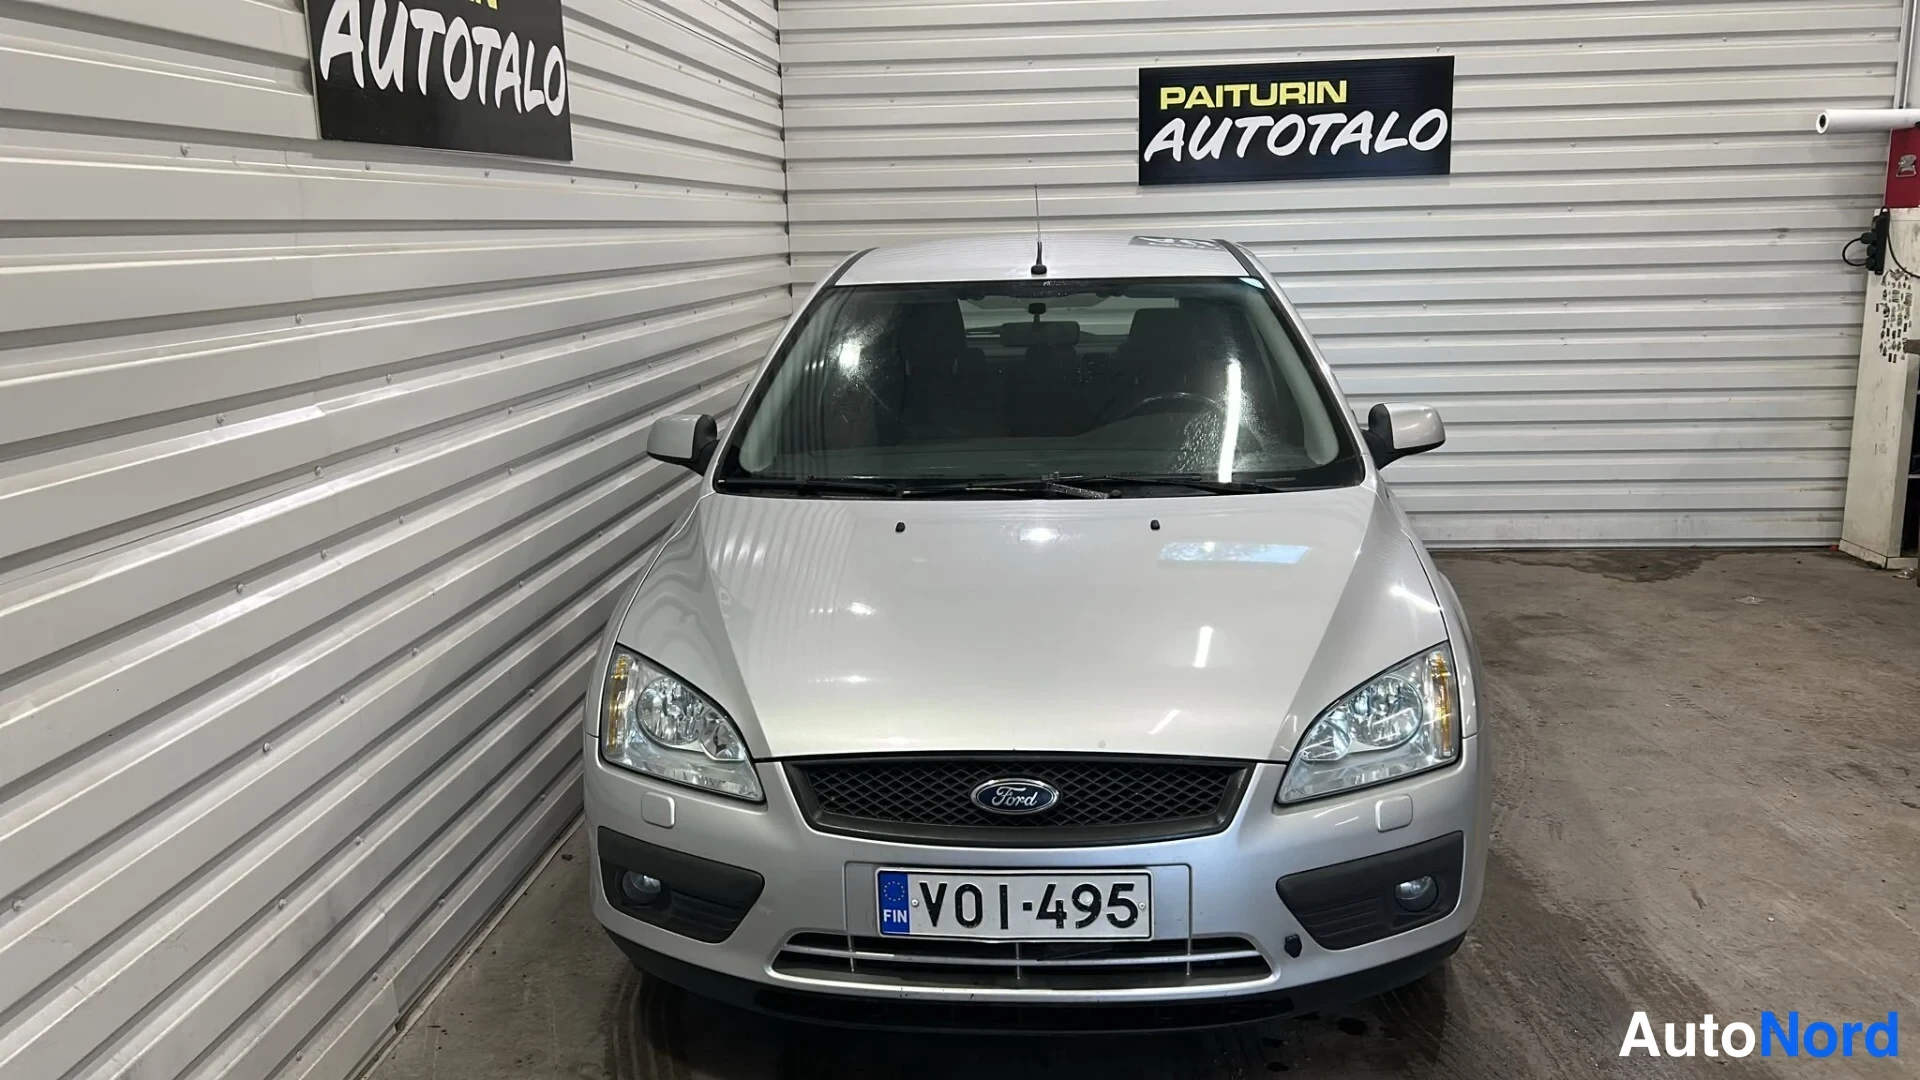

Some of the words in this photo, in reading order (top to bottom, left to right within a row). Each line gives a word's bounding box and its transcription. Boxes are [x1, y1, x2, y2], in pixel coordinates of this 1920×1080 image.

[319, 0, 566, 117] AUTOTALO
[1160, 80, 1347, 110] PAITURIN
[1143, 108, 1448, 162] AUTOTALO
[991, 786, 1039, 807] Ford
[883, 908, 907, 924] FIN
[919, 882, 1139, 930] VOI-495
